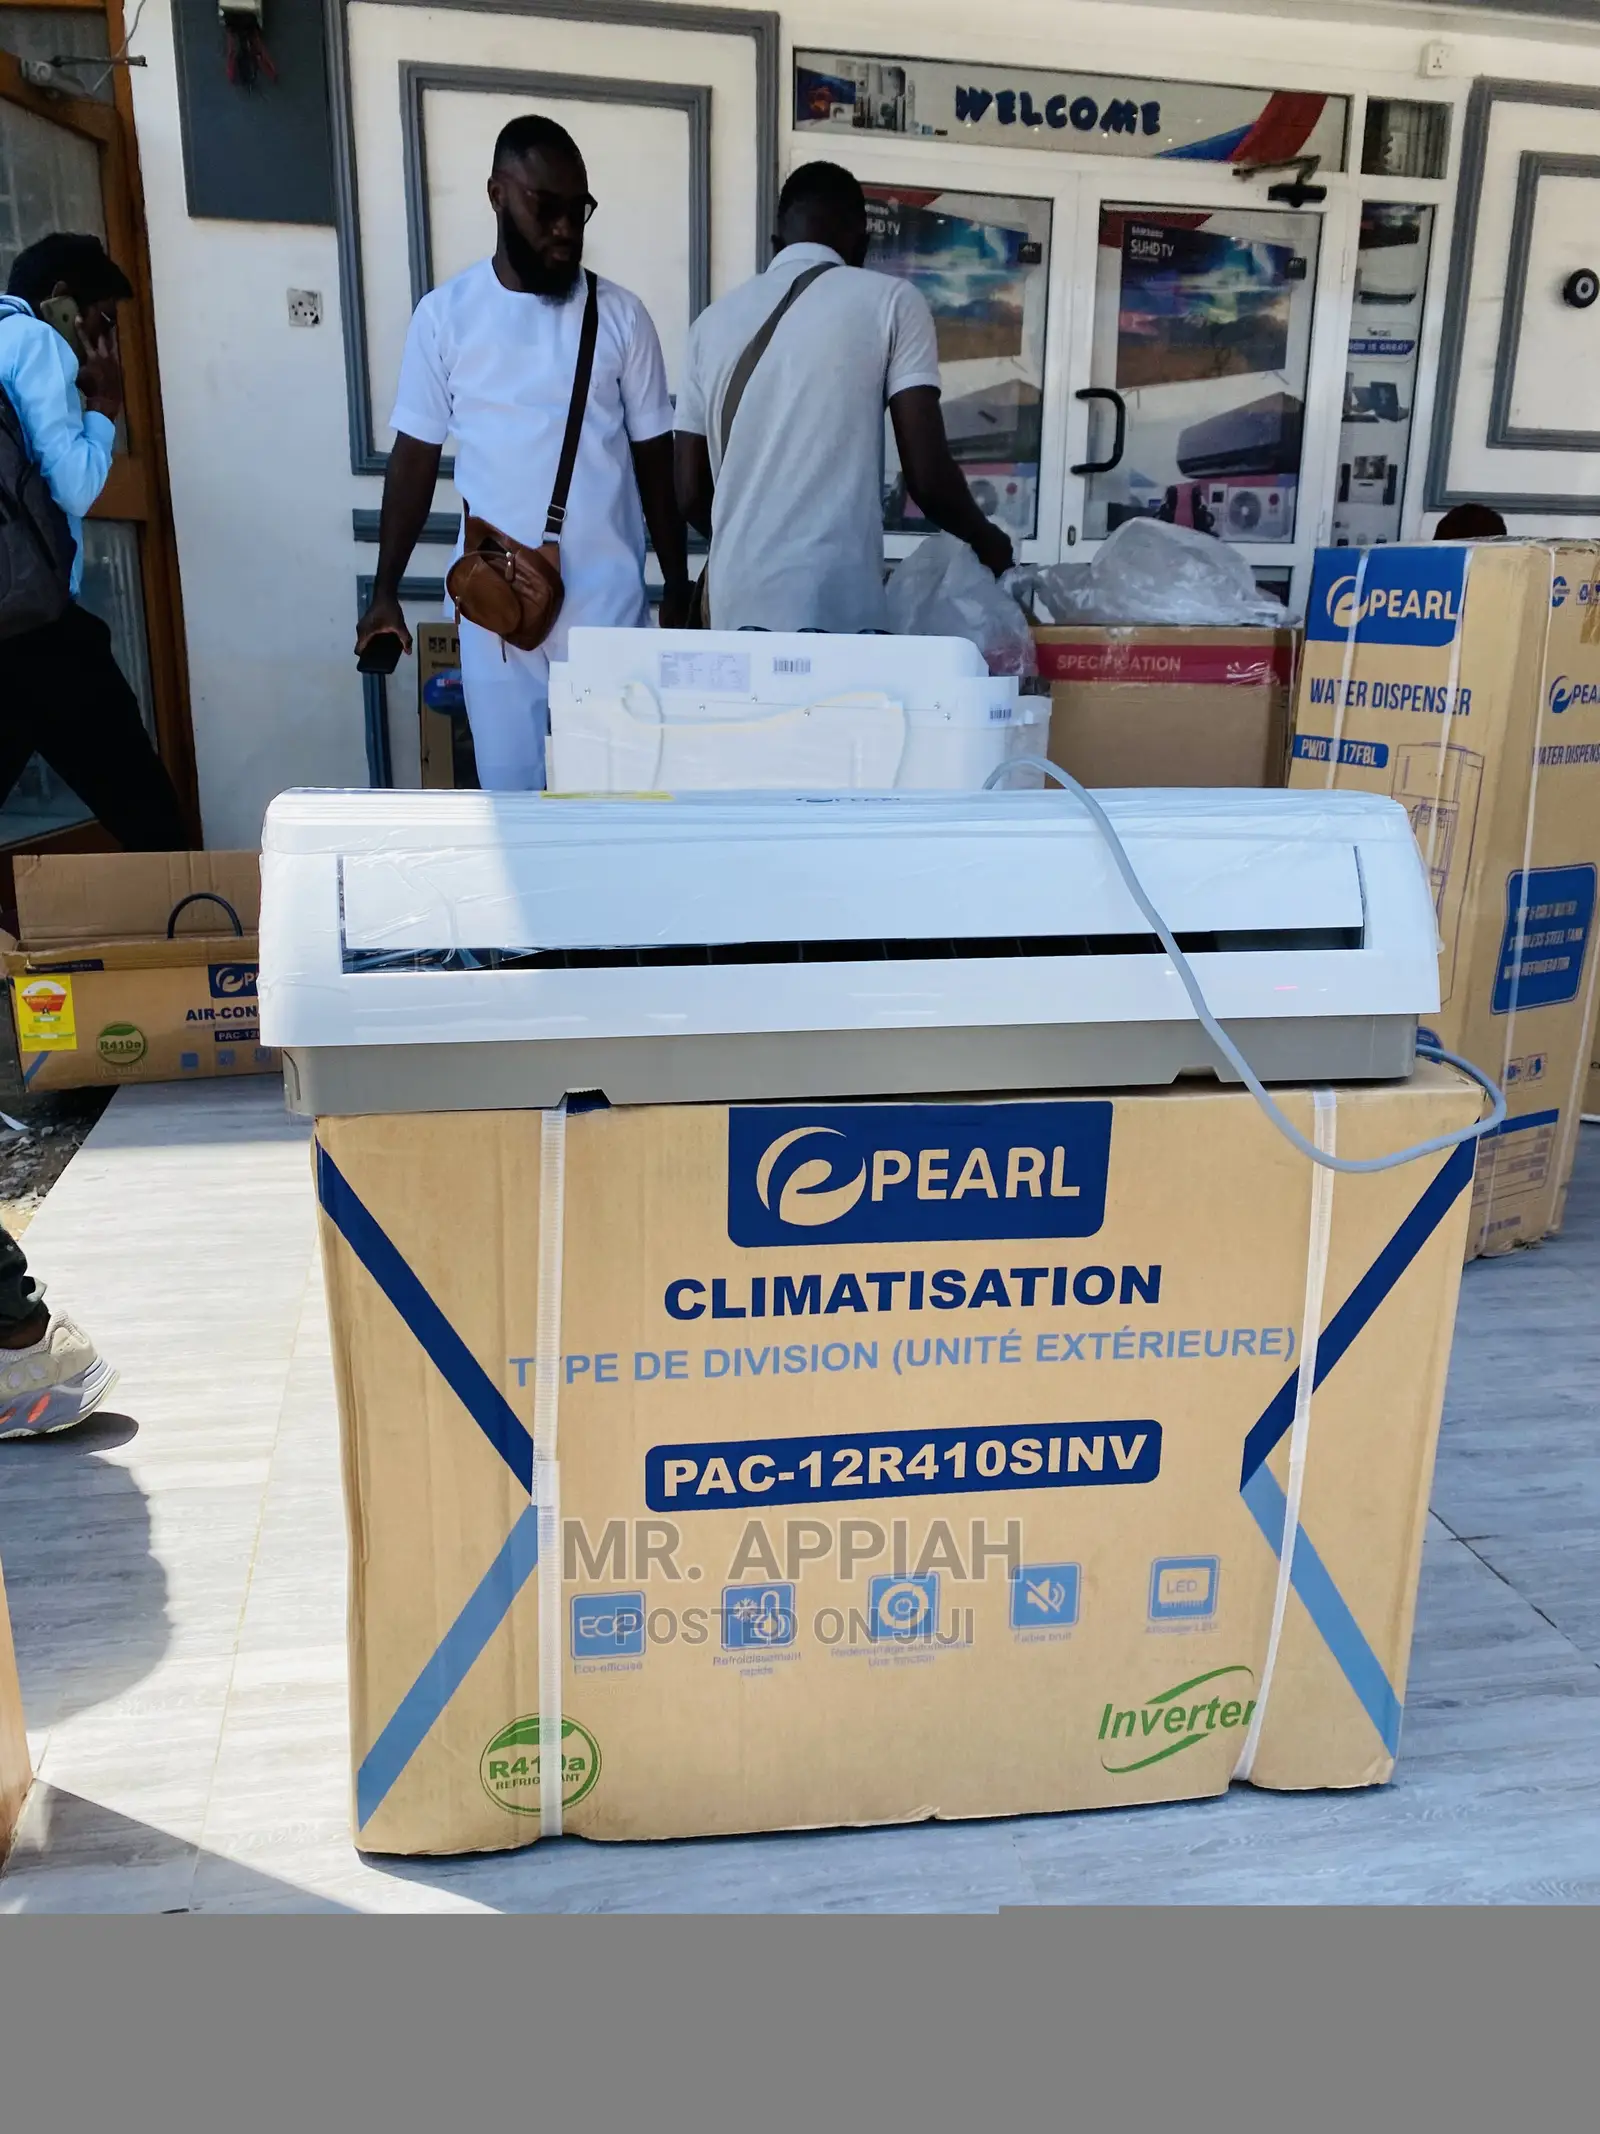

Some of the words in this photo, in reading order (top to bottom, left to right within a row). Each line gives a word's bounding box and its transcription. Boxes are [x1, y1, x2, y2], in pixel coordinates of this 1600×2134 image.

[955, 86, 1161, 136] WELCOME
[1130, 239, 1160, 255] SUHD
[1161, 243, 1175, 257] TV
[1369, 588, 1457, 620] PEARL
[1057, 655, 1181, 672] SPECIFICATION
[1572, 683, 1600, 705] PEA
[1301, 738, 1326, 760] PWD
[100, 1040, 141, 1050] R410a
[871, 1146, 1080, 1203] PEARL
[664, 1265, 1162, 1320] CLIMATISATION
[509, 1353, 618, 1387] TPE
[634, 1350, 689, 1381] DE
[704, 1341, 878, 1378] DIVISION
[893, 1328, 1022, 1375] (UNITÉ
[1036, 1325, 1296, 1362] EXTÉRIEURE)
[663, 1434, 1148, 1497] PAC-12R410SINV
[1166, 1579, 1198, 1594] LED
[1098, 1695, 1257, 1740] Inverter
[496, 1773, 581, 1790] REFRIGNT
